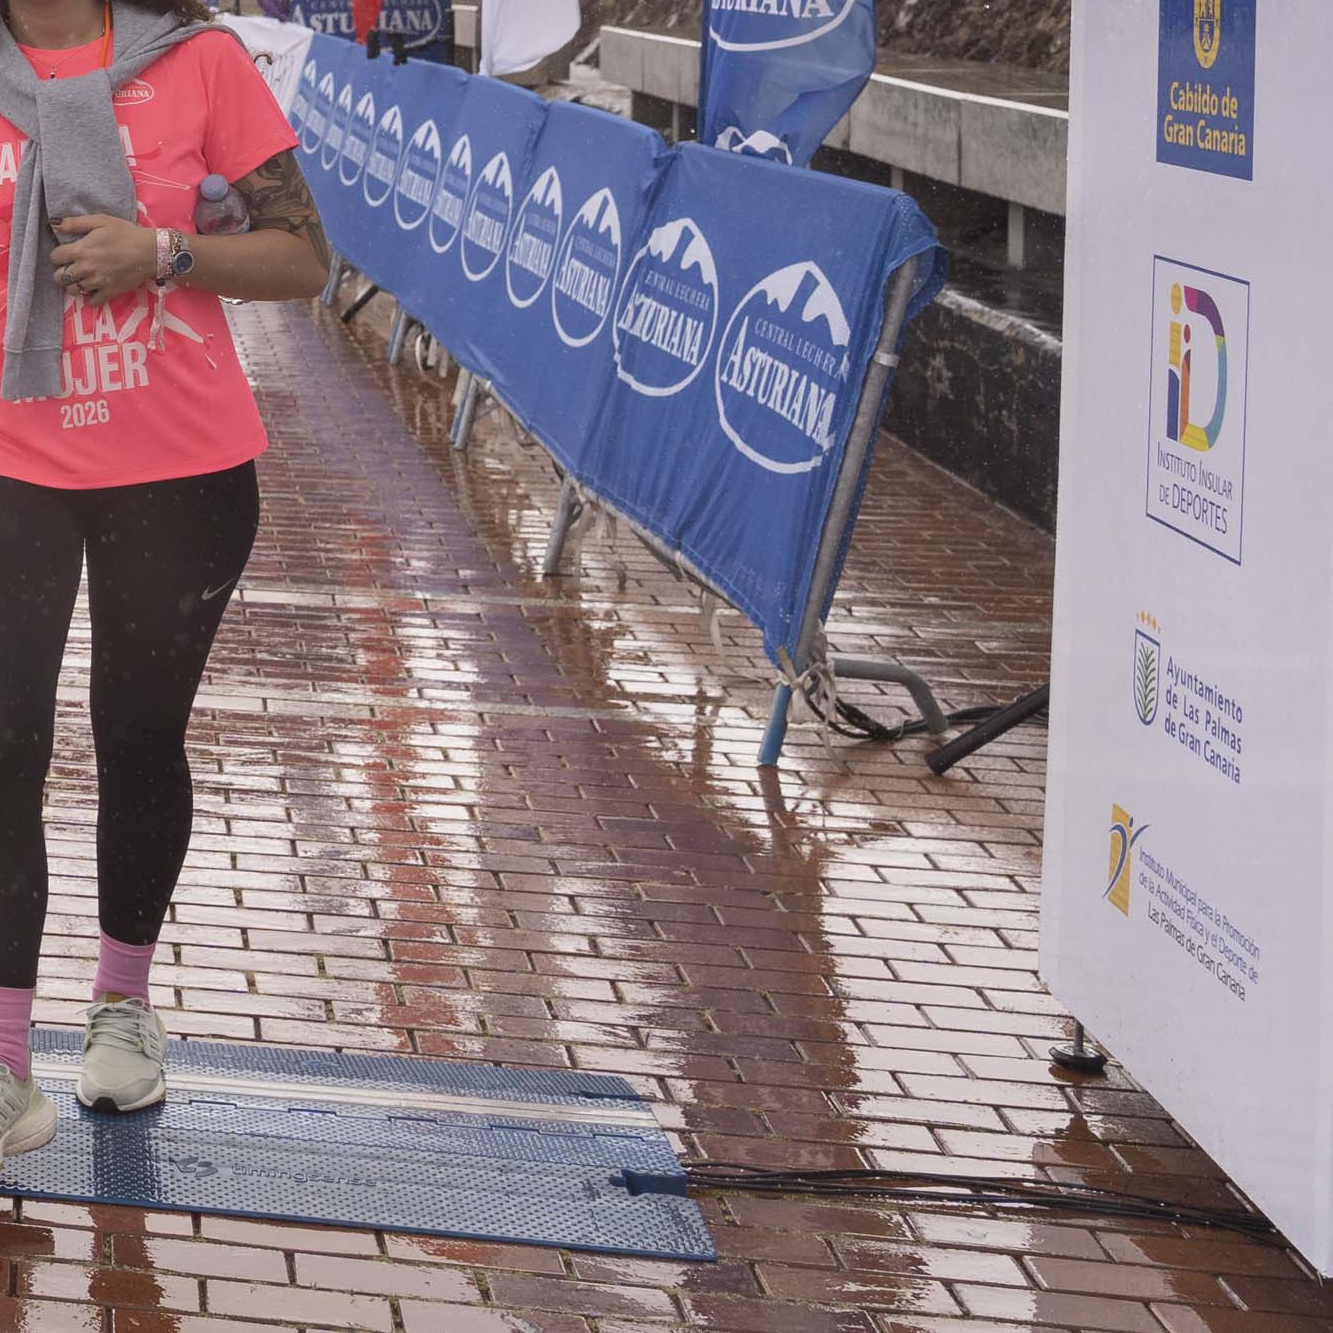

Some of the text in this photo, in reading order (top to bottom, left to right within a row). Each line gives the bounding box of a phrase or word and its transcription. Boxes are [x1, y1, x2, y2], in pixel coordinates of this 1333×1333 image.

[1171, 80, 1238, 120] Cabildo de
[1164, 114, 1246, 157] Gran Canaria
[556, 235, 612, 318] ASTURIANA
[75, 300, 119, 346] LA
[755, 319, 794, 350] CENTRAL
[18, 346, 149, 404] UJER
[60, 401, 109, 428] 2026
[1157, 442, 1233, 500] INSTITUTO INSULAR
[1160, 483, 1227, 534] DE DEPORTES
[1167, 656, 1242, 723] Ayuntamiento
[1165, 712, 1241, 784] de Gran Canaria
[1166, 684, 1242, 754] de Las Palmas
[1140, 846, 1260, 962] Instituto Municipal para la Promoción
[1148, 900, 1245, 1002] Las Palmas de Gran Canaria
